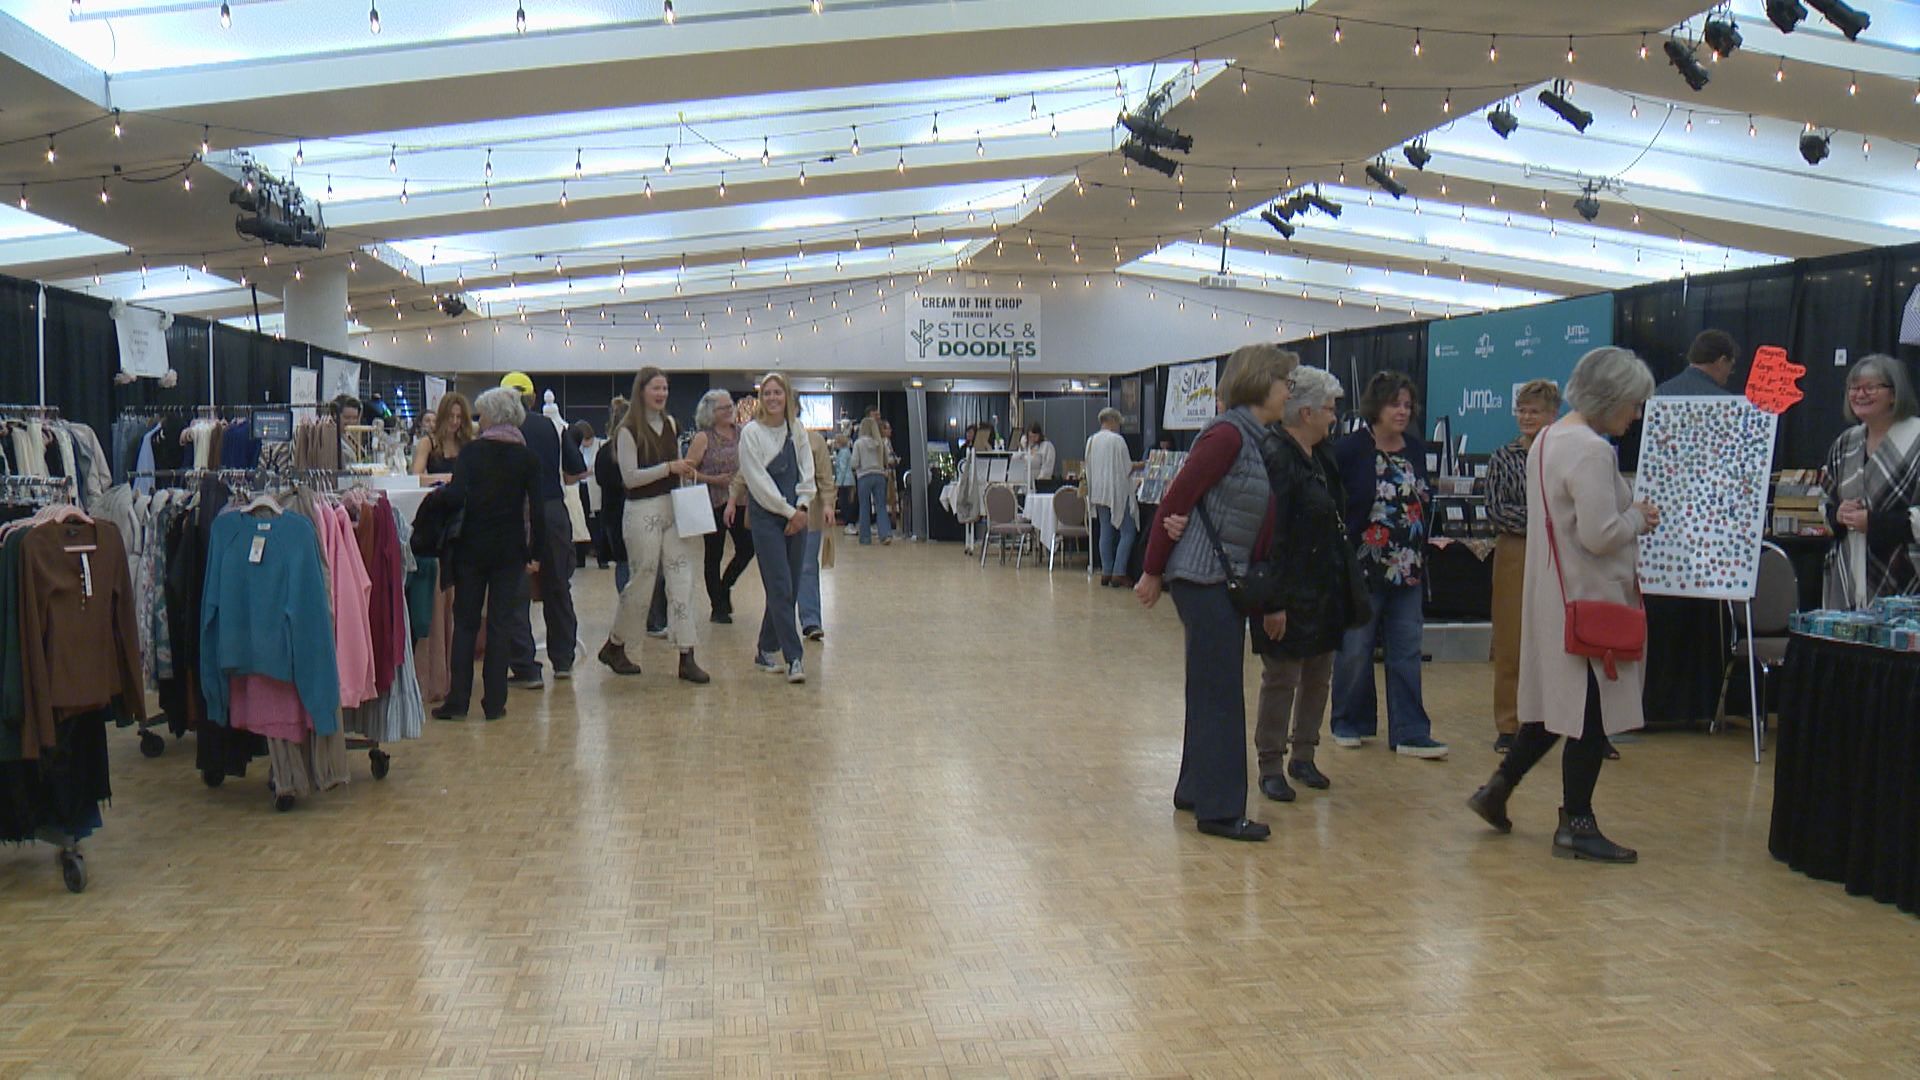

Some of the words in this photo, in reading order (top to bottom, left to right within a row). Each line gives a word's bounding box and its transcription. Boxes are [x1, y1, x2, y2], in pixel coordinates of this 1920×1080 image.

[922, 297, 956, 308] CREAM
[959, 297, 972, 308] OF
[974, 297, 992, 308] THE
[995, 298, 1023, 309] CROP
[938, 323, 1015, 338] STICKS
[1022, 323, 1036, 338] &
[938, 341, 1036, 357] DOODLES
